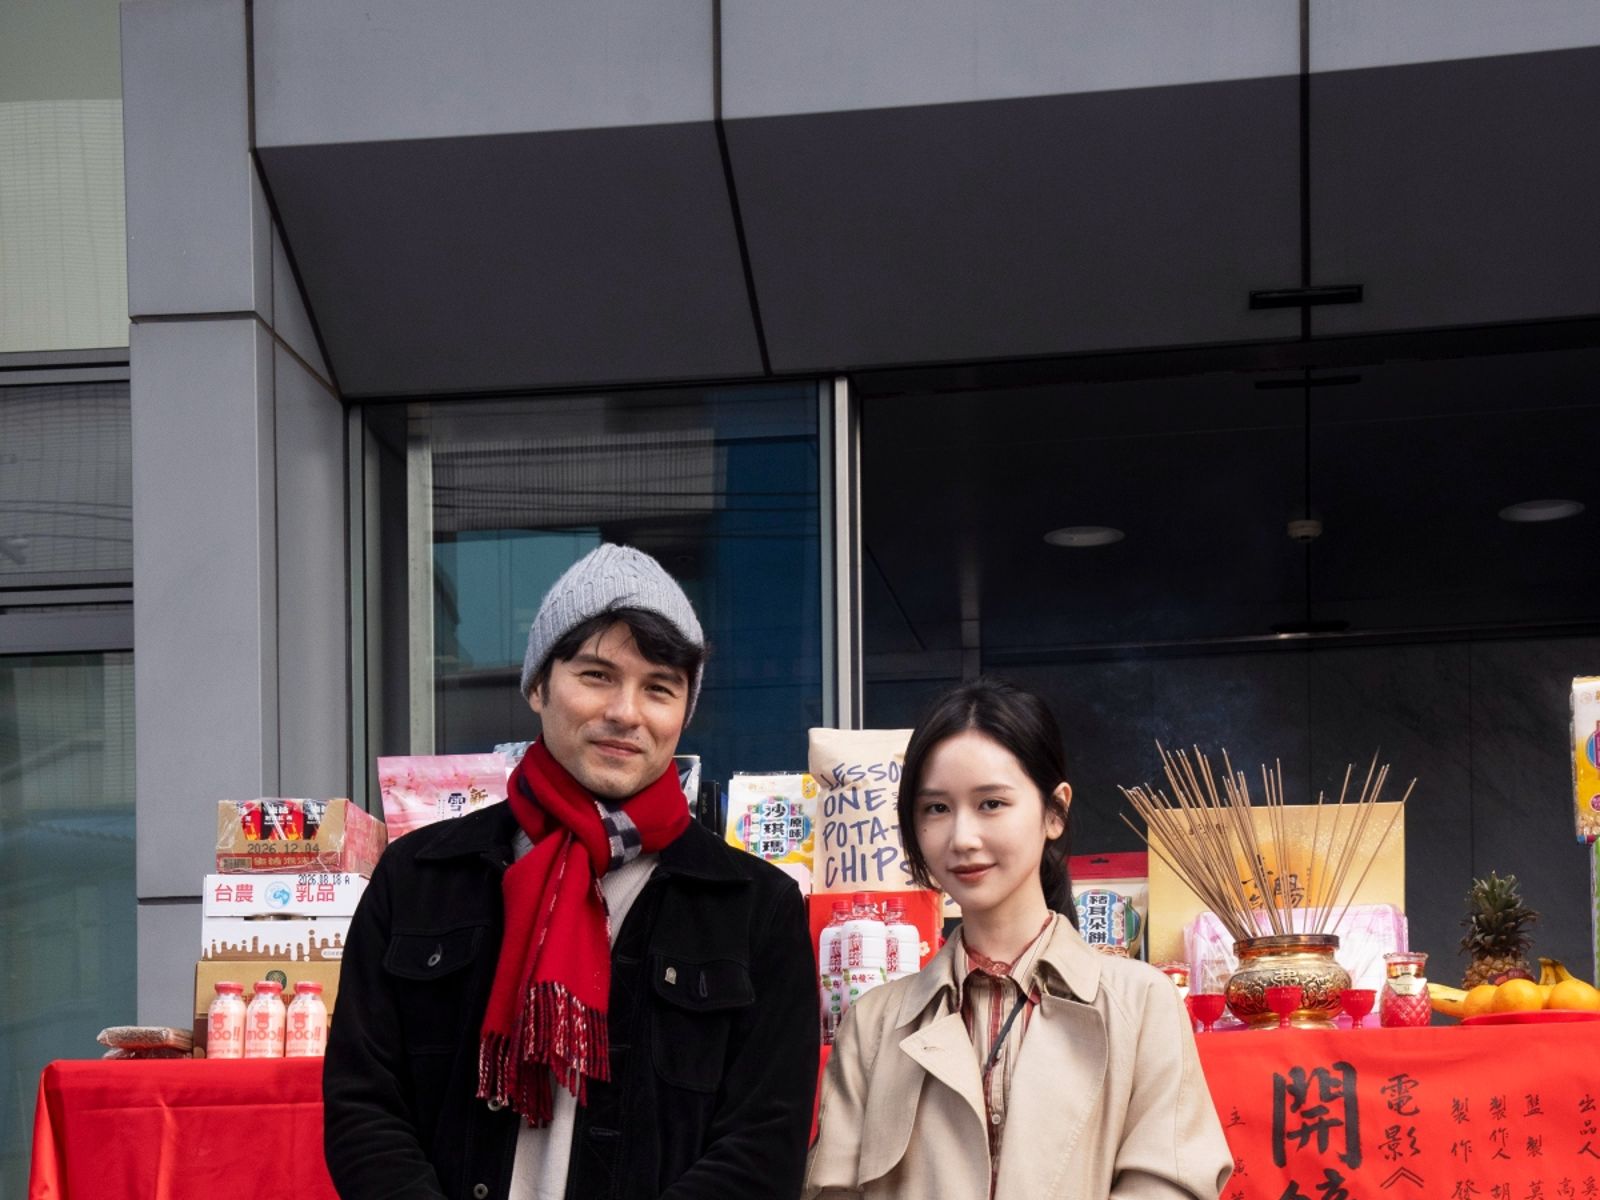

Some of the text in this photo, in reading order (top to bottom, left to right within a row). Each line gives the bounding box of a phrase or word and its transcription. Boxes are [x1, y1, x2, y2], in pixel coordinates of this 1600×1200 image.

[821, 762, 904, 792] LESSO
[824, 786, 886, 818] ONE
[763, 803, 786, 853] 沙琪瑪
[215, 883, 254, 903] 台農
[296, 882, 335, 902] 乳品
[1451, 1098, 1473, 1163] 製作
[1489, 1095, 1512, 1160] 製作人
[1578, 1094, 1600, 1159] 出品人
